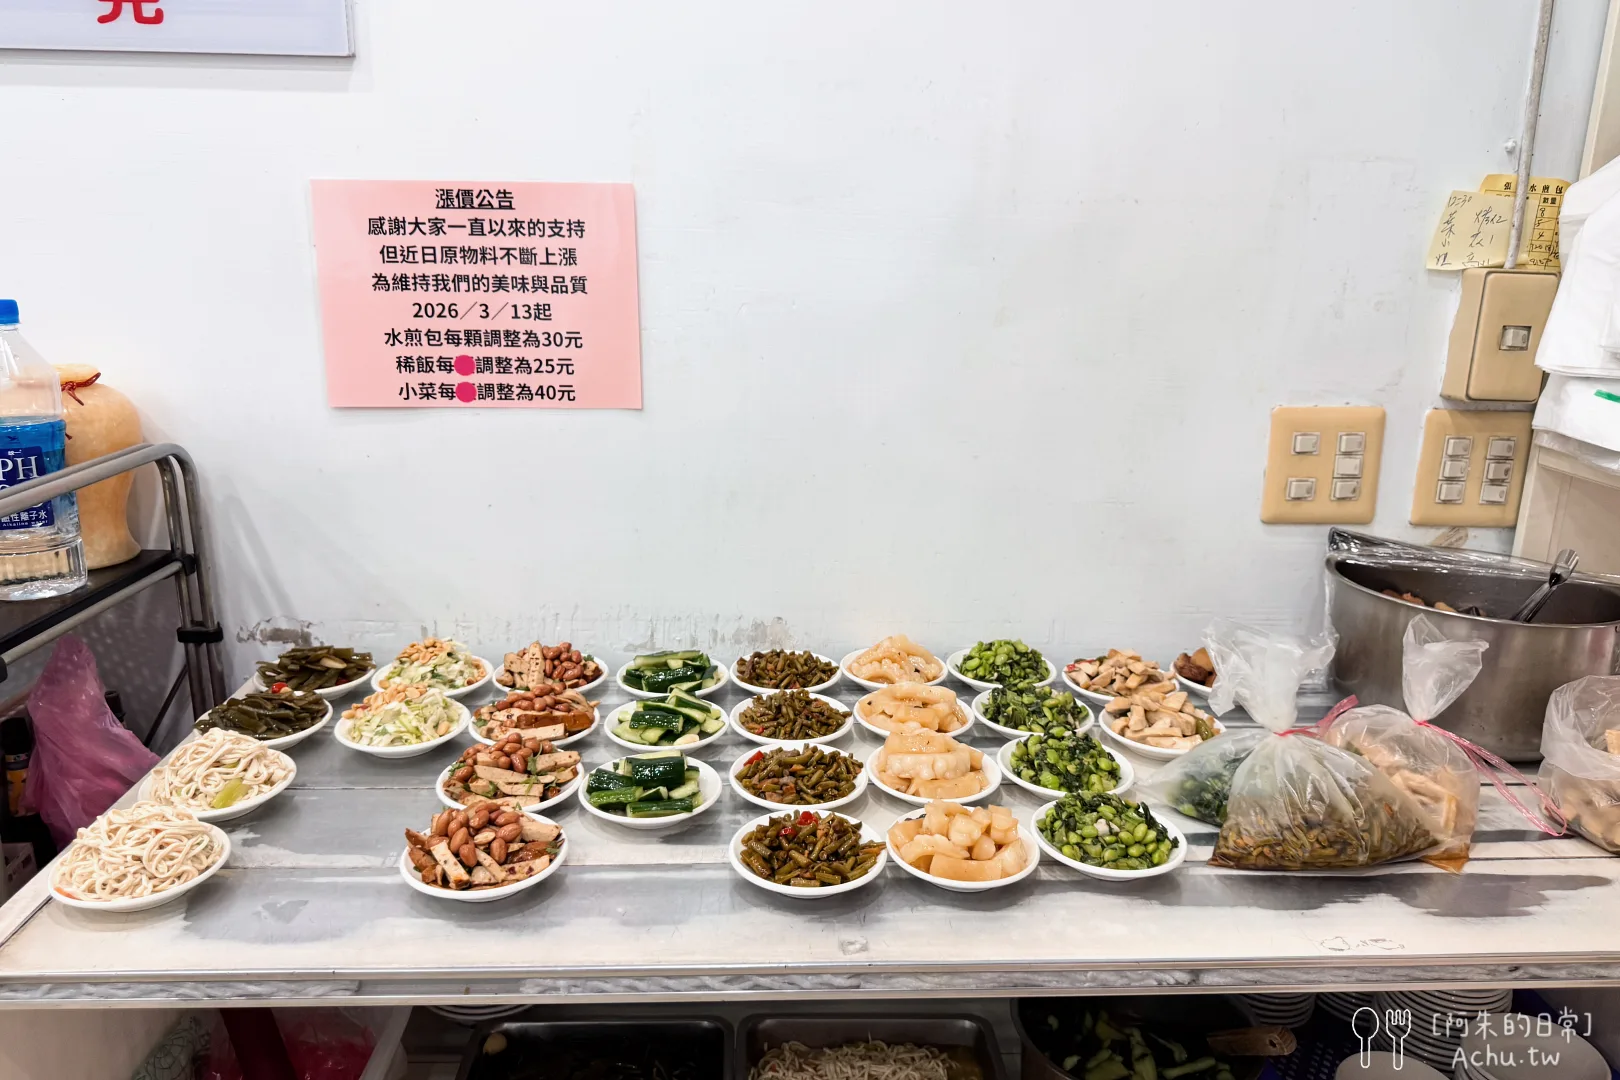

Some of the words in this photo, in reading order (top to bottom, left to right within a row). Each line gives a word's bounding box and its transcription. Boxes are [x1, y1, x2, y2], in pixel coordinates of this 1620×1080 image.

[436, 189, 515, 210] 漲價公告
[368, 216, 585, 238] 感謝大家一直以來的支持
[380, 245, 577, 266] 但近日原物料不斷上漲
[372, 273, 587, 294] 為維持我們的美味與品質
[385, 328, 582, 348] 水煎包每顆調整為30元
[396, 355, 574, 376] 稀飯每調整為25元
[399, 382, 575, 402] 小菜每調整為40元
